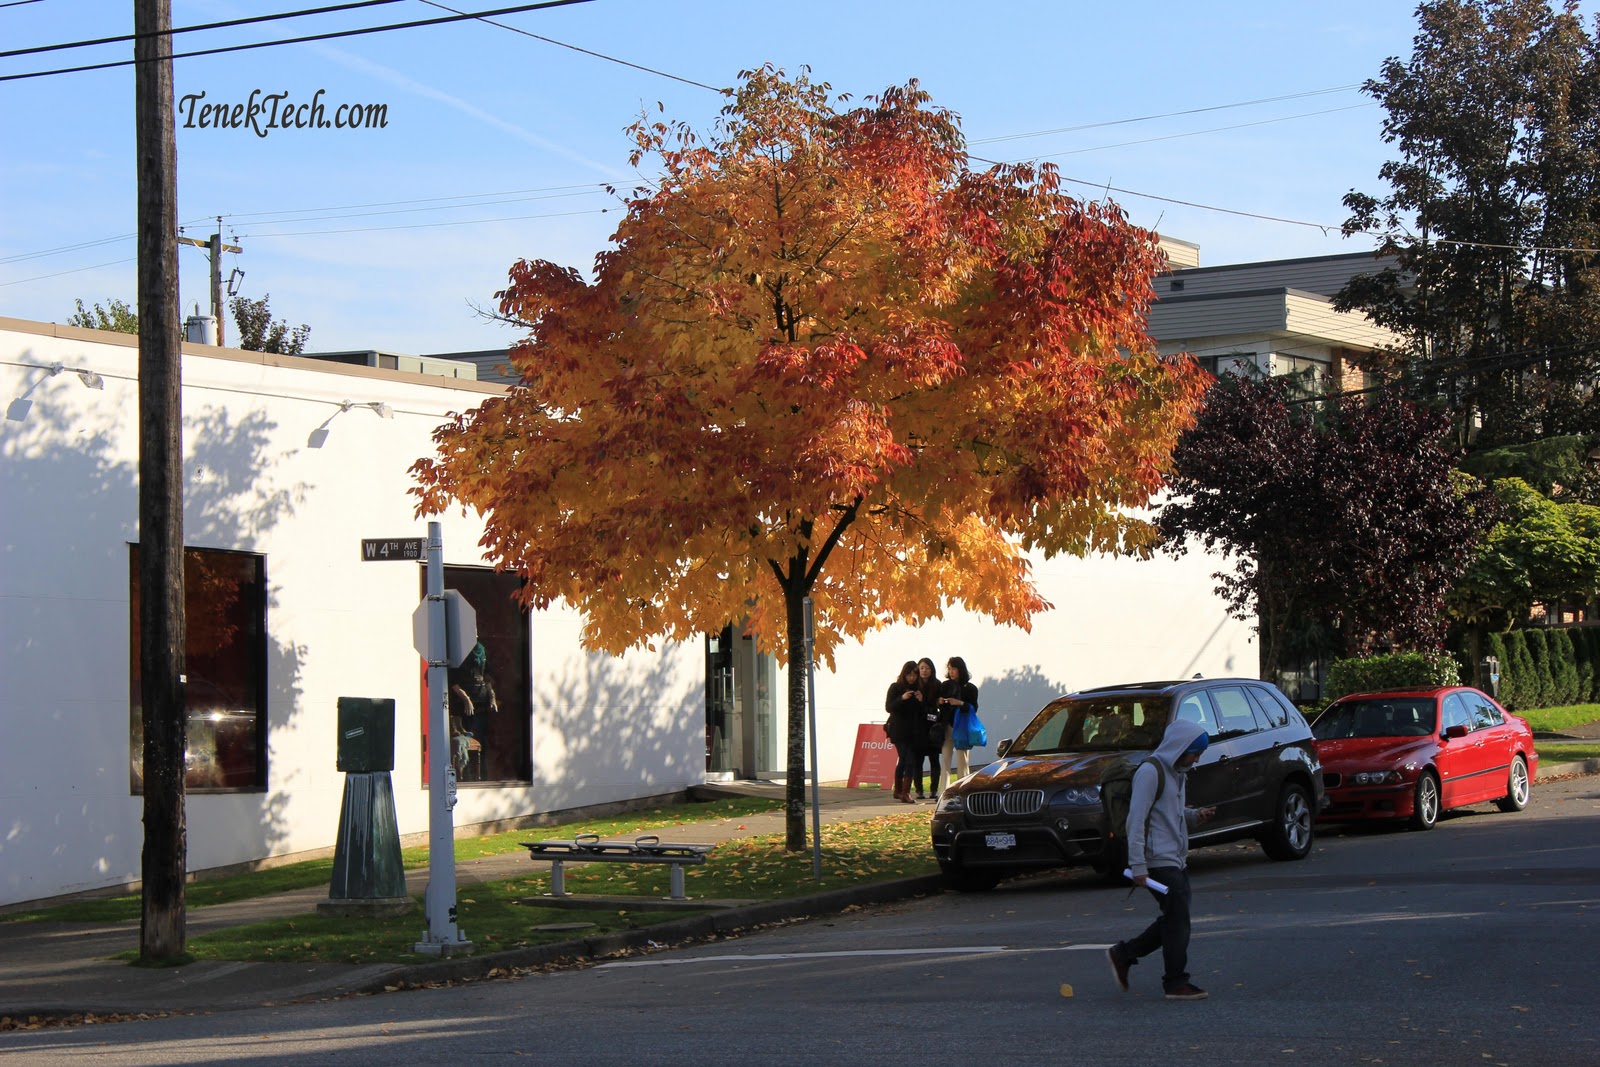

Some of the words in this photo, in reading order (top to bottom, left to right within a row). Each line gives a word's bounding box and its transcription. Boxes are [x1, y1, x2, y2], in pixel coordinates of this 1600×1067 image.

[366, 543, 377, 557] W
[380, 542, 399, 557] 4TH
[404, 542, 418, 550] AVE
[403, 550, 418, 558] 1900
